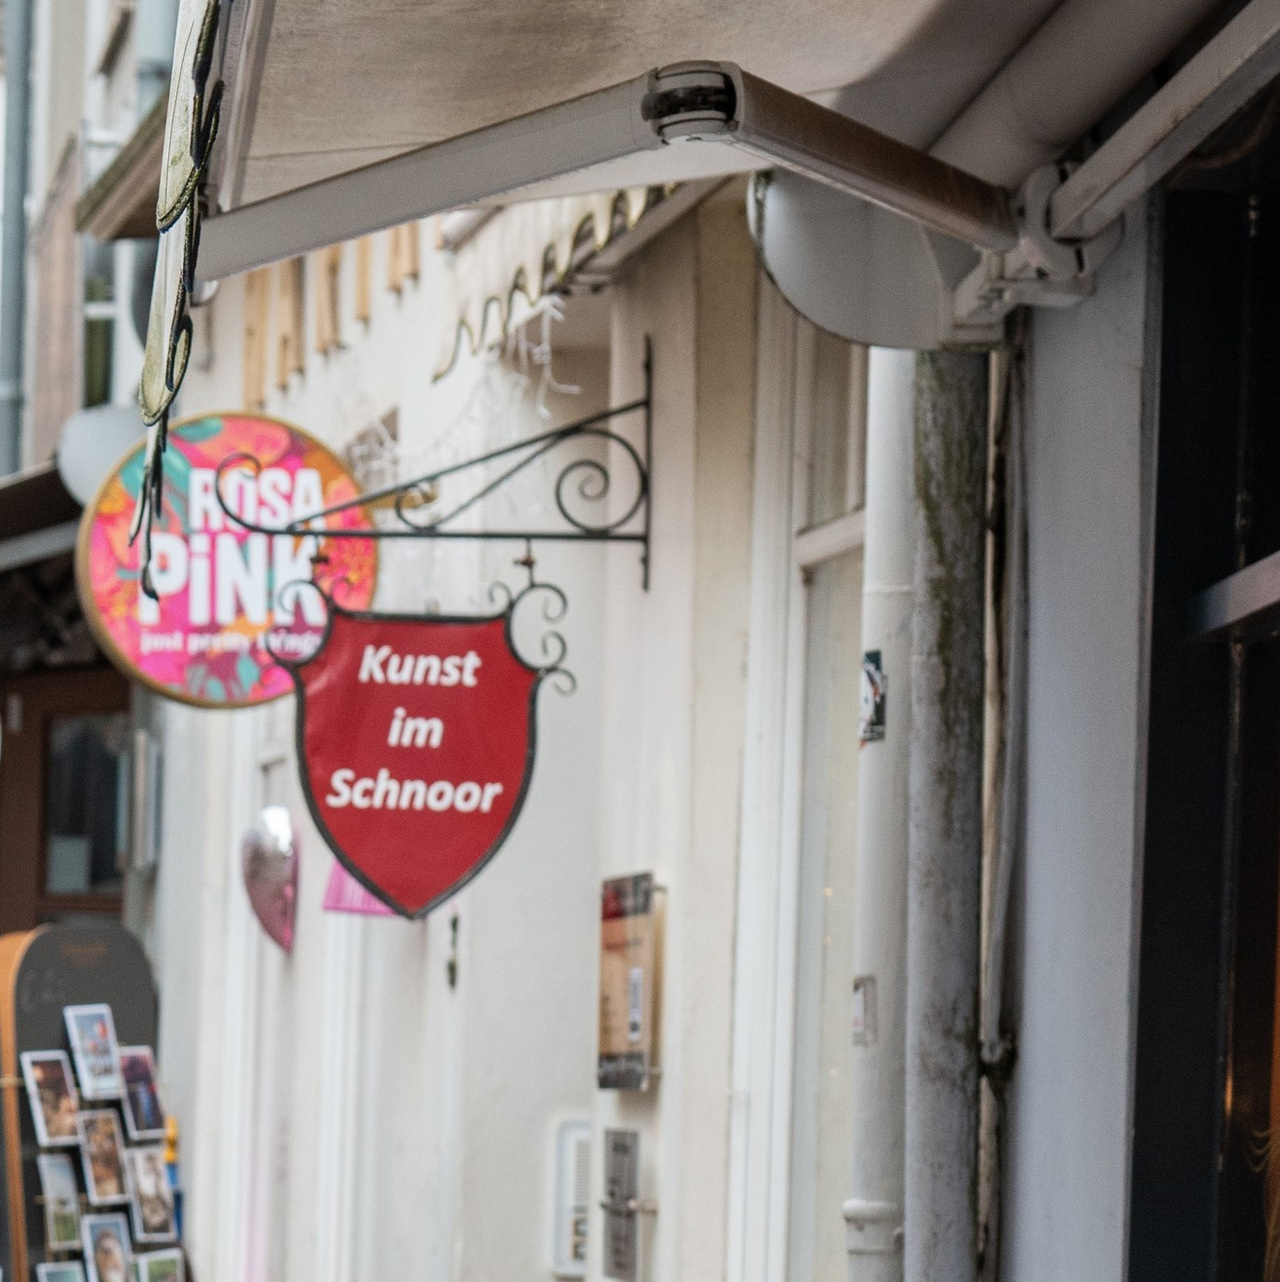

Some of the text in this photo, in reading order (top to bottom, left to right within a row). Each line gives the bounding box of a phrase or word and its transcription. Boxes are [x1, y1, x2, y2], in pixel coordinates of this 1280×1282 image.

[189, 467, 325, 533] ROSA
[358, 644, 482, 688] Kunst
[386, 706, 444, 749] im
[325, 767, 504, 813] Schnoor
